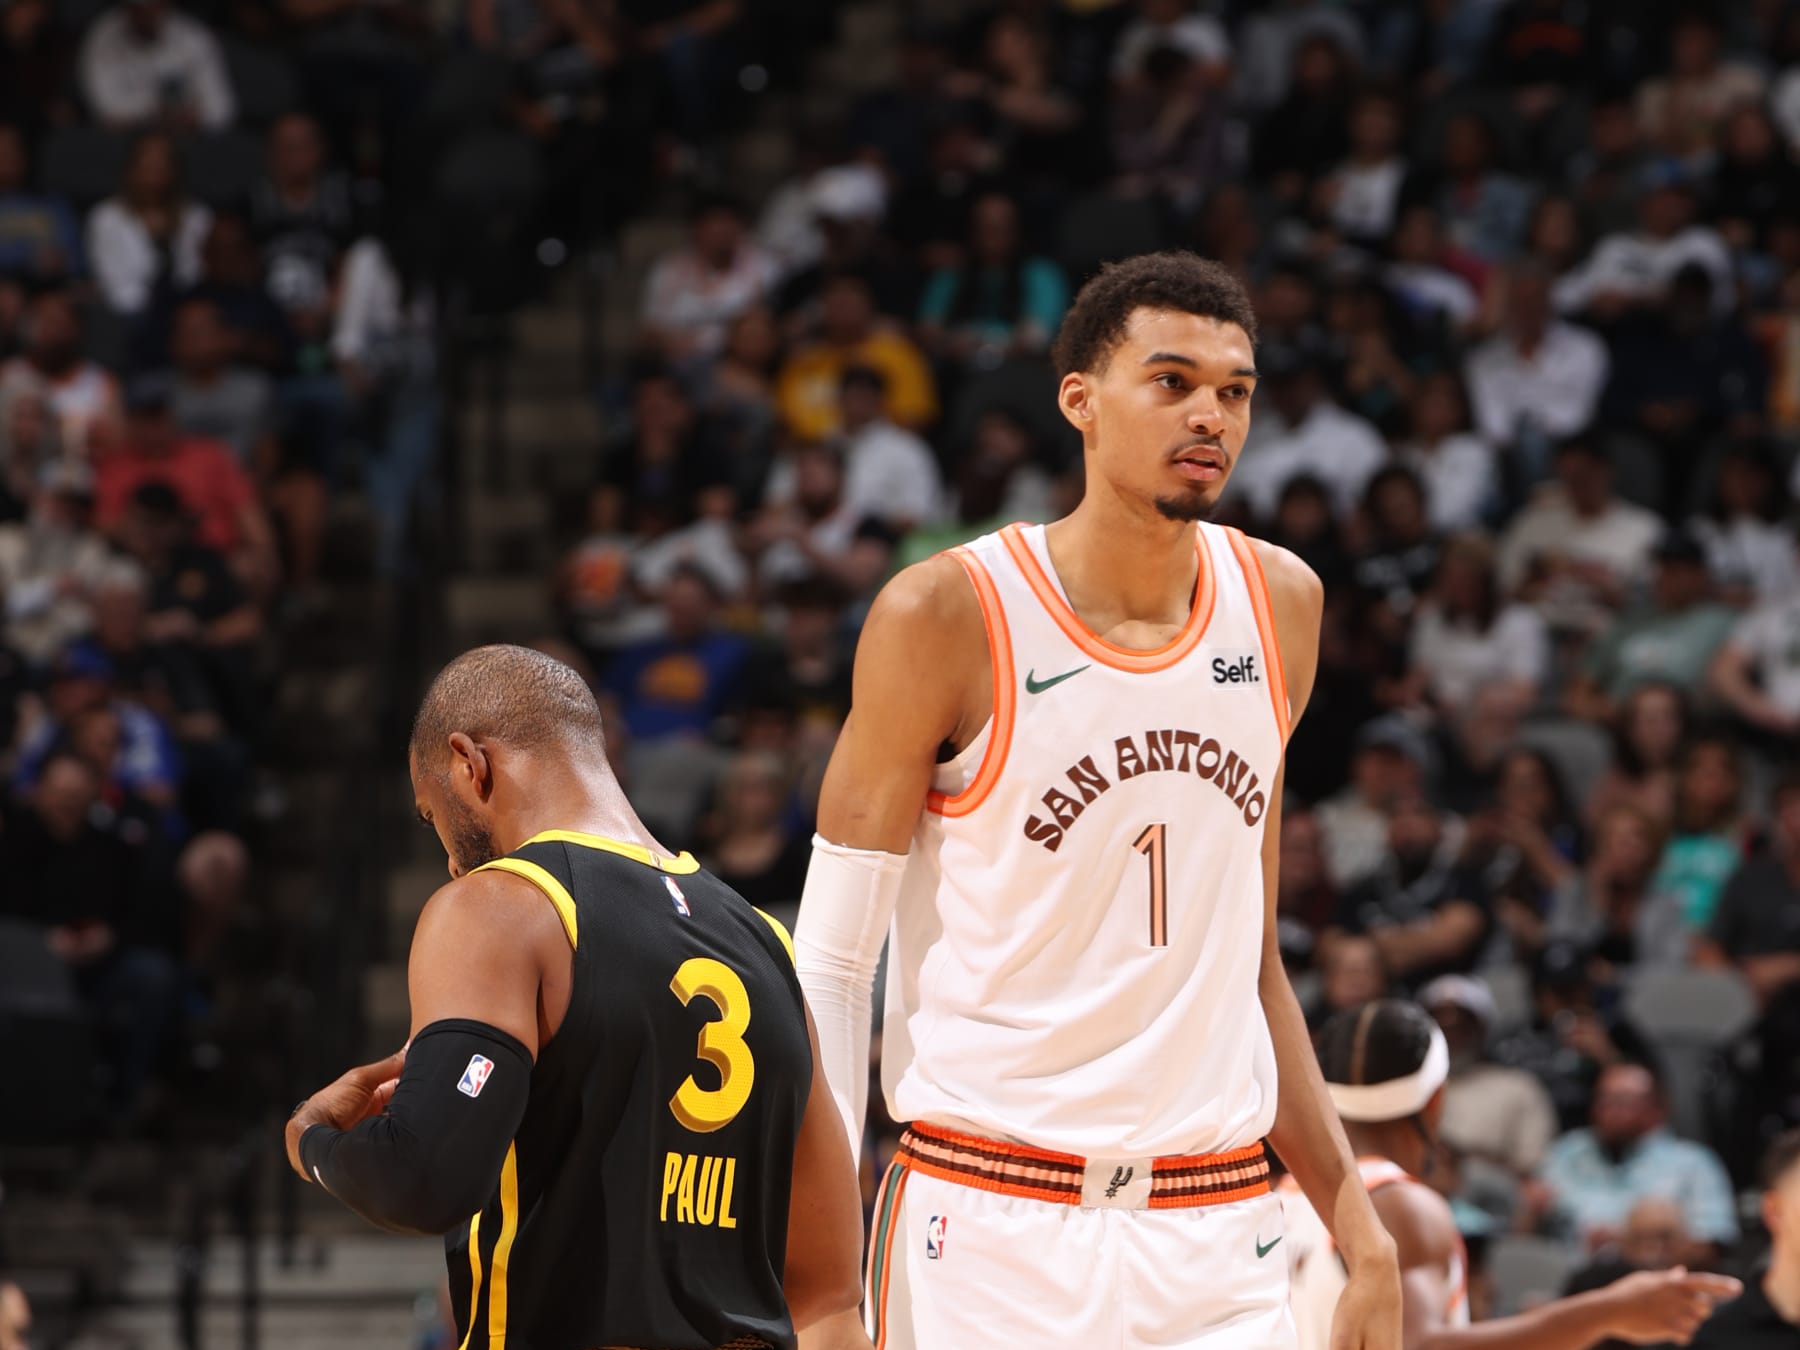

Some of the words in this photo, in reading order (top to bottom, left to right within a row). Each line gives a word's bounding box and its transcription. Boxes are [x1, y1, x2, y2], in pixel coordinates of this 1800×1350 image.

[1212, 656, 1259, 684] Self.
[1024, 755, 1111, 853] SAN
[1114, 729, 1266, 827] ANTONIO
[1132, 823, 1168, 947] 1
[669, 957, 755, 1133] 3
[659, 1151, 737, 1229] PAUL
